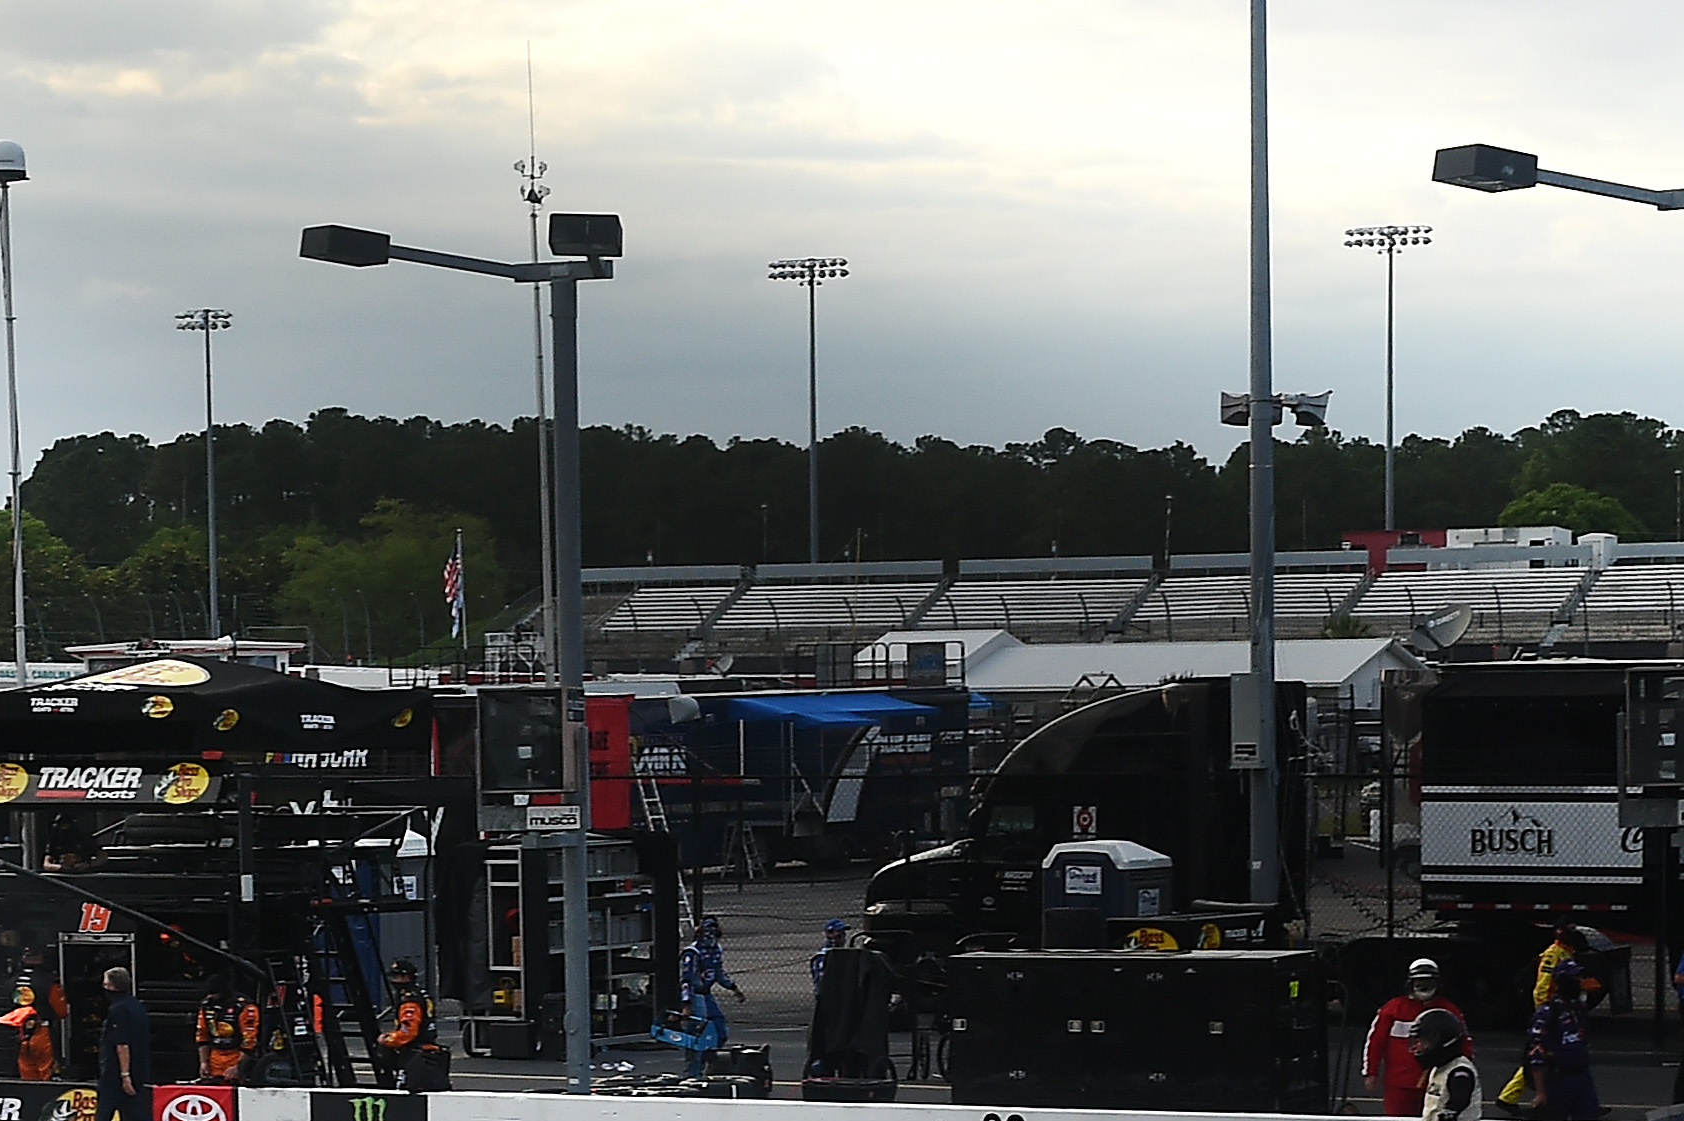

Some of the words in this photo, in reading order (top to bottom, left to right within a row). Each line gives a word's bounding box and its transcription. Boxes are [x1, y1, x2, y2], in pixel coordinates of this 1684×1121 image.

[30, 698, 79, 707] TRACKER
[178, 763, 200, 775] Bass
[37, 767, 143, 789] TRACKER
[86, 788, 136, 800] boats
[173, 786, 201, 799] Shops
[529, 816, 578, 826] musco
[1470, 828, 1553, 855] BUSCH
[78, 902, 112, 933] 19
[72, 1091, 97, 1110] Bas
